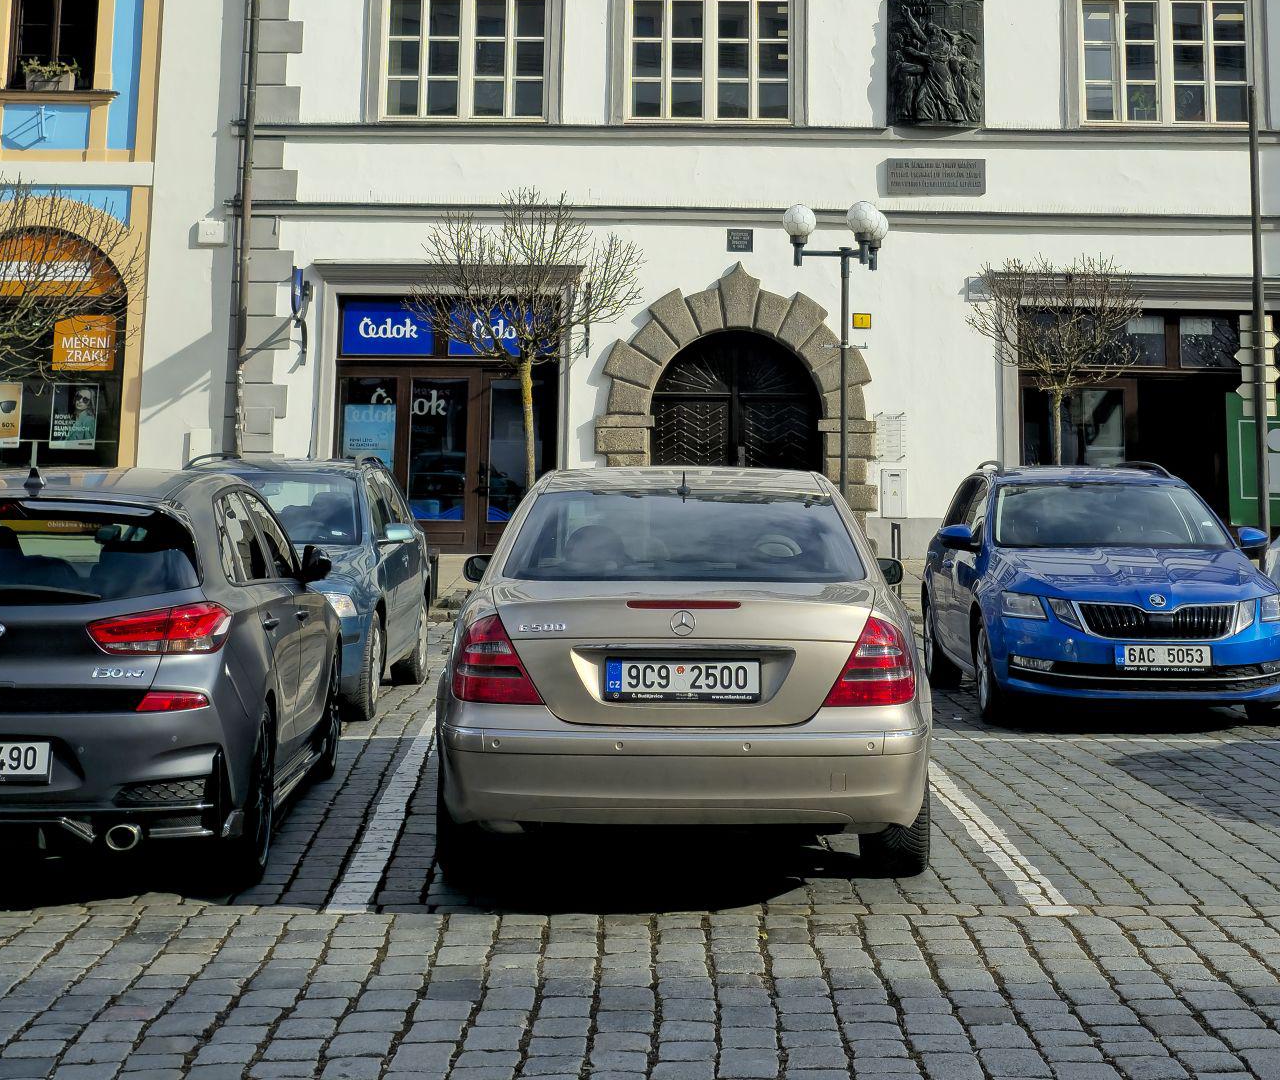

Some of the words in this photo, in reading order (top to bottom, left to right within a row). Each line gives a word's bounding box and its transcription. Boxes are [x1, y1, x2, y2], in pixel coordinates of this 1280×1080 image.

[359, 317, 419, 339] Čedok
[472, 318, 530, 340] Čedo
[1128, 648, 1155, 663] 6AC
[1167, 648, 1204, 664] 5053
[609, 680, 621, 689] CZ
[627, 664, 671, 689] 9C9
[689, 665, 748, 690] 2500
